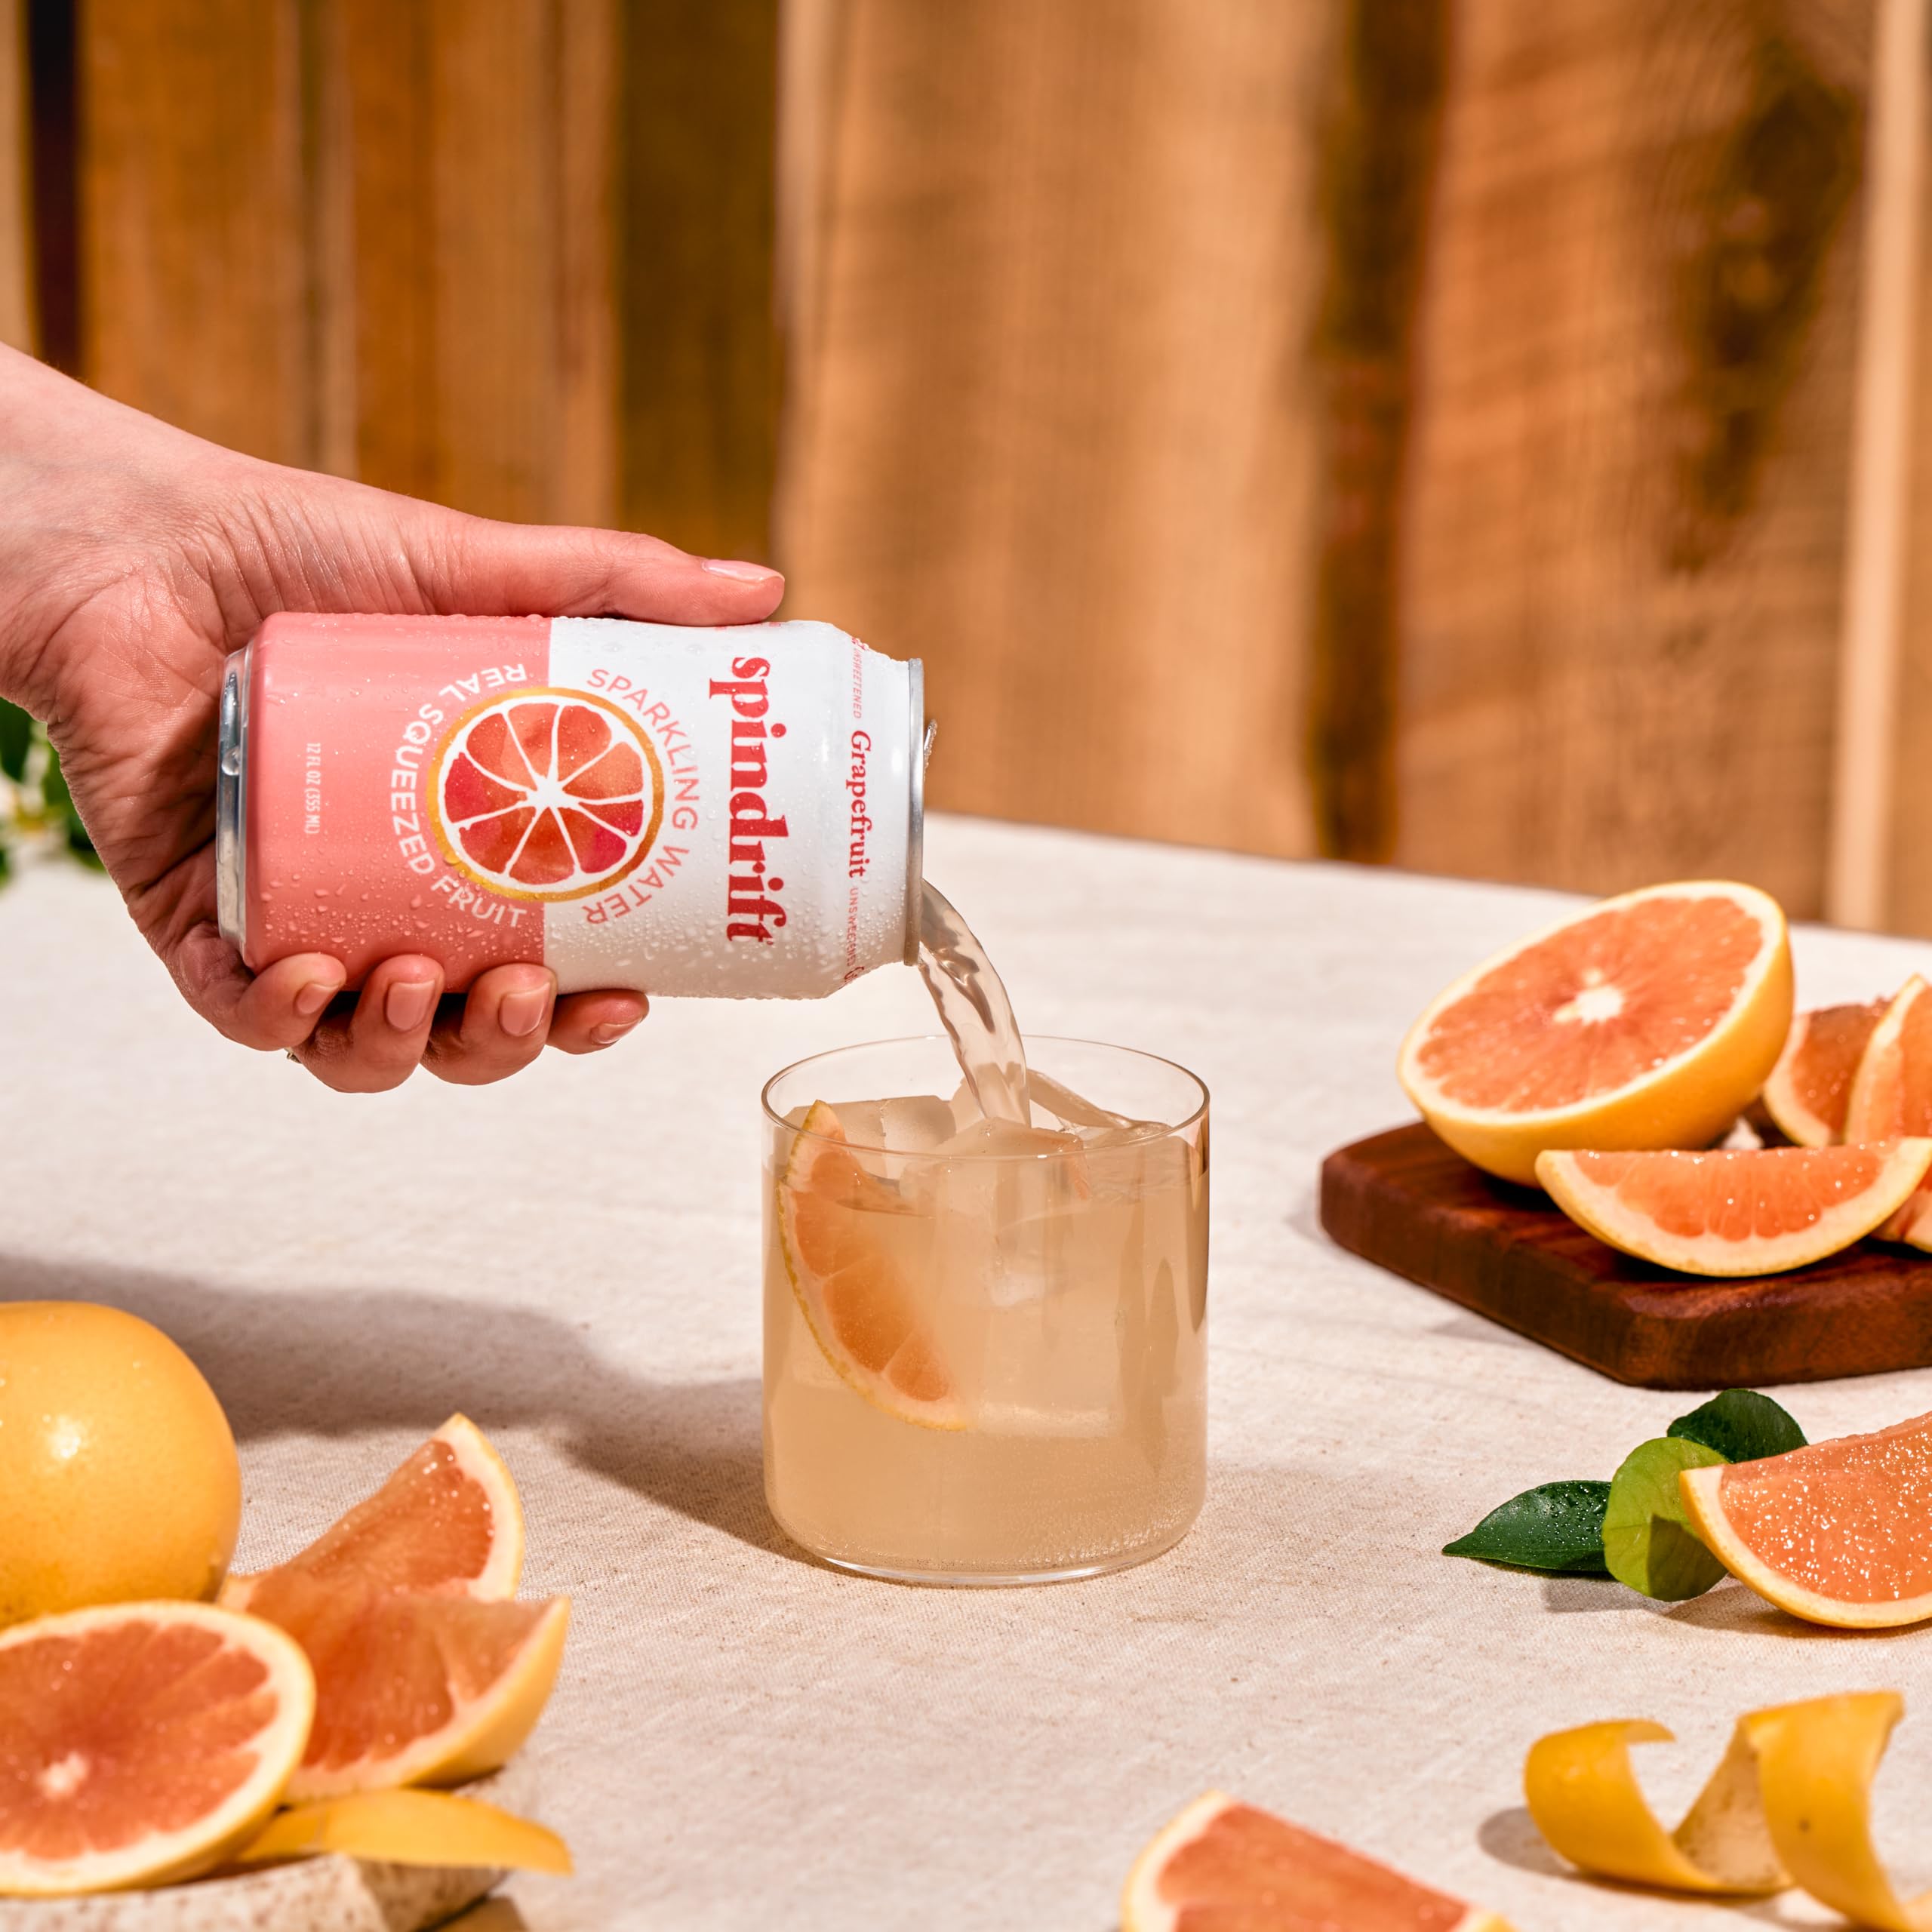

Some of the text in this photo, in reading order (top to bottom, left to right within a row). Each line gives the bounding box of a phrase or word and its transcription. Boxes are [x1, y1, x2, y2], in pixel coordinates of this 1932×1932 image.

[853, 648, 863, 719] UNSWEETENED
[304, 743, 321, 834] 12 FL OZ (355 ML)
[390, 663, 528, 928] REAL SQUEEZED FRUIT
[582, 669, 701, 925] SPARKLING WATER
[709, 657, 789, 943] spindrift
[845, 730, 872, 878] Grapefruit
